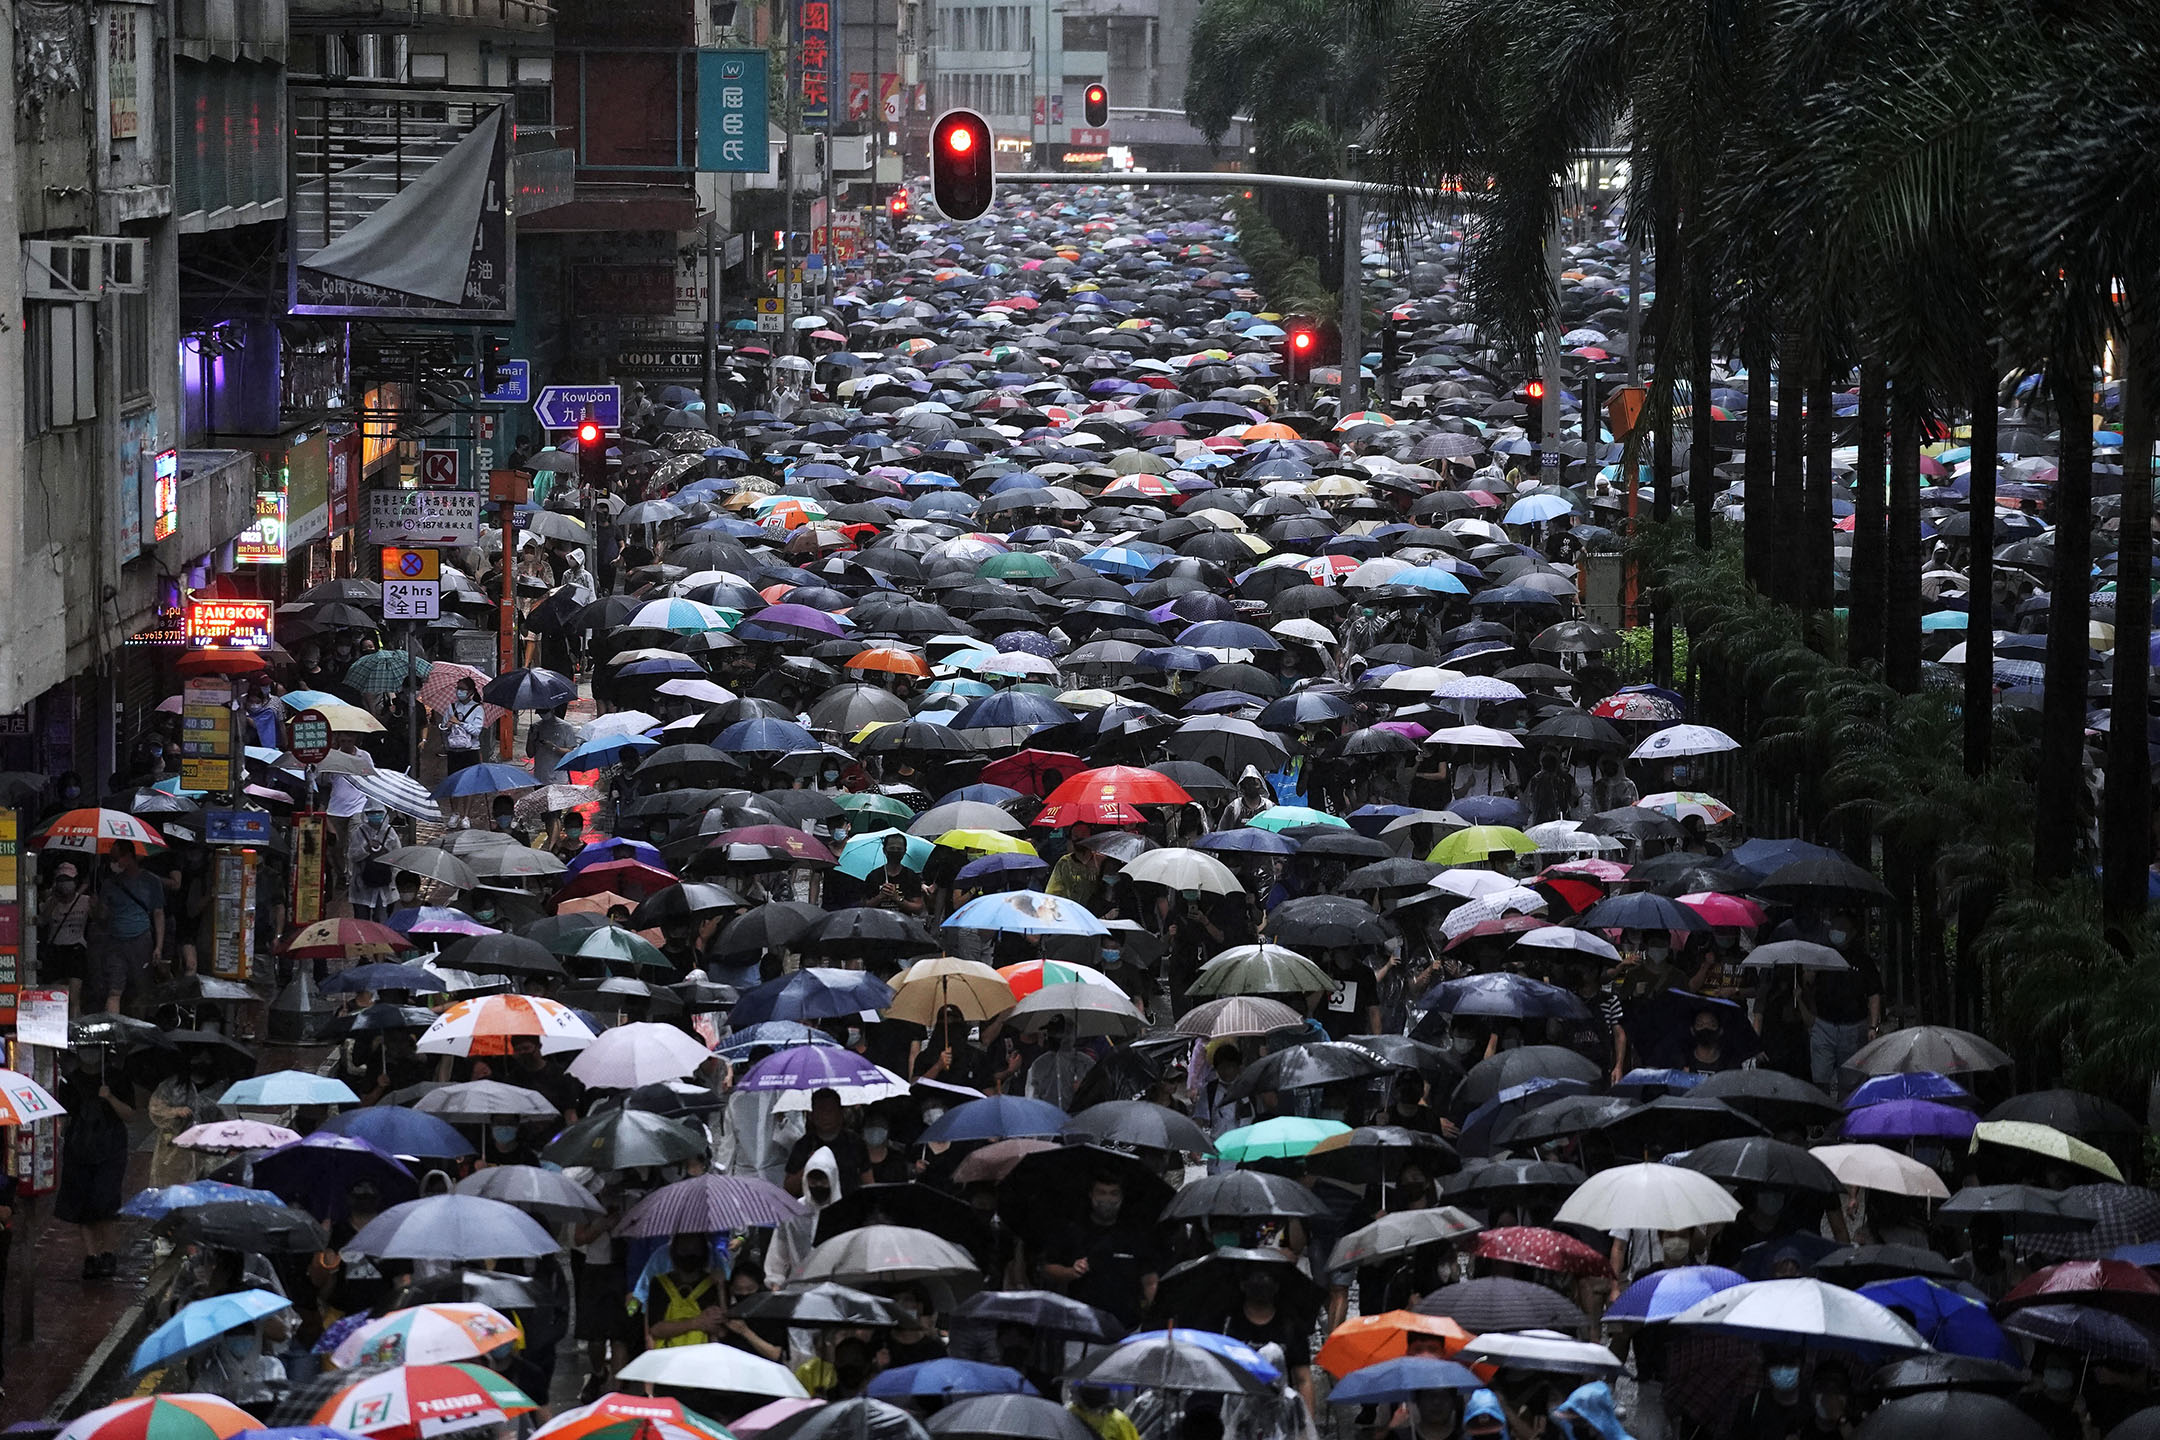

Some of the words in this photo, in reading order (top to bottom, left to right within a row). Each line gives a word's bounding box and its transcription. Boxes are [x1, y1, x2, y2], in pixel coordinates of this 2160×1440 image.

[618, 353, 665, 366] COOL
[496, 367, 523, 376] amar
[562, 391, 611, 403] Kowloon
[265, 502, 279, 514] SPA
[456, 509, 472, 517] POON
[390, 585, 409, 599] 24
[412, 585, 433, 596] hrs
[194, 606, 266, 620] BANGKOK
[394, 600, 428, 615] 全日
[164, 630, 181, 640] 9711
